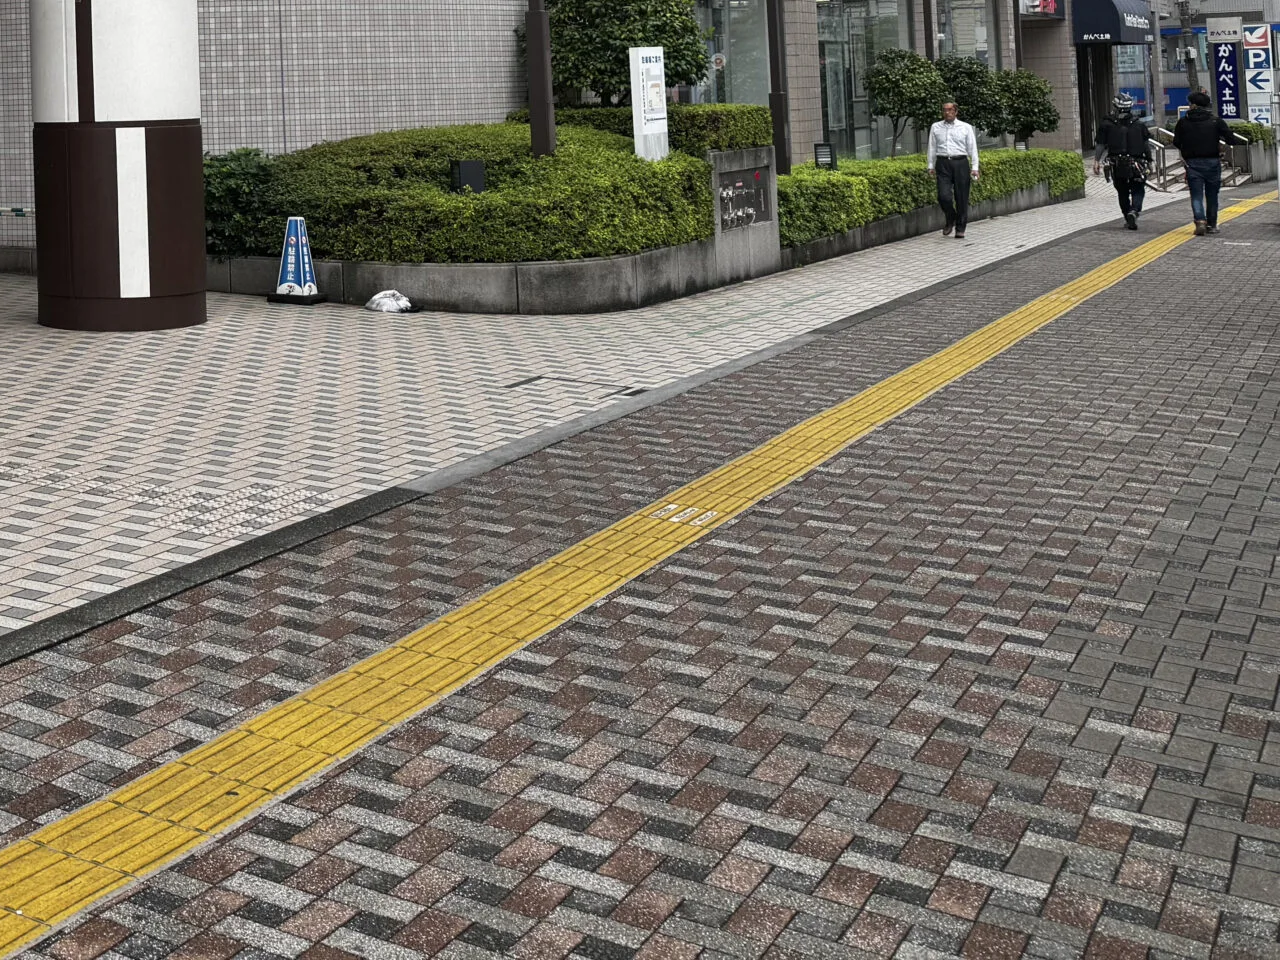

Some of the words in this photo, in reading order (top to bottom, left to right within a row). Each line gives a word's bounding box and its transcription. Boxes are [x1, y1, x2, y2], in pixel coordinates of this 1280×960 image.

[1218, 43, 1237, 116] かんべ土地
[1248, 49, 1266, 68] P
